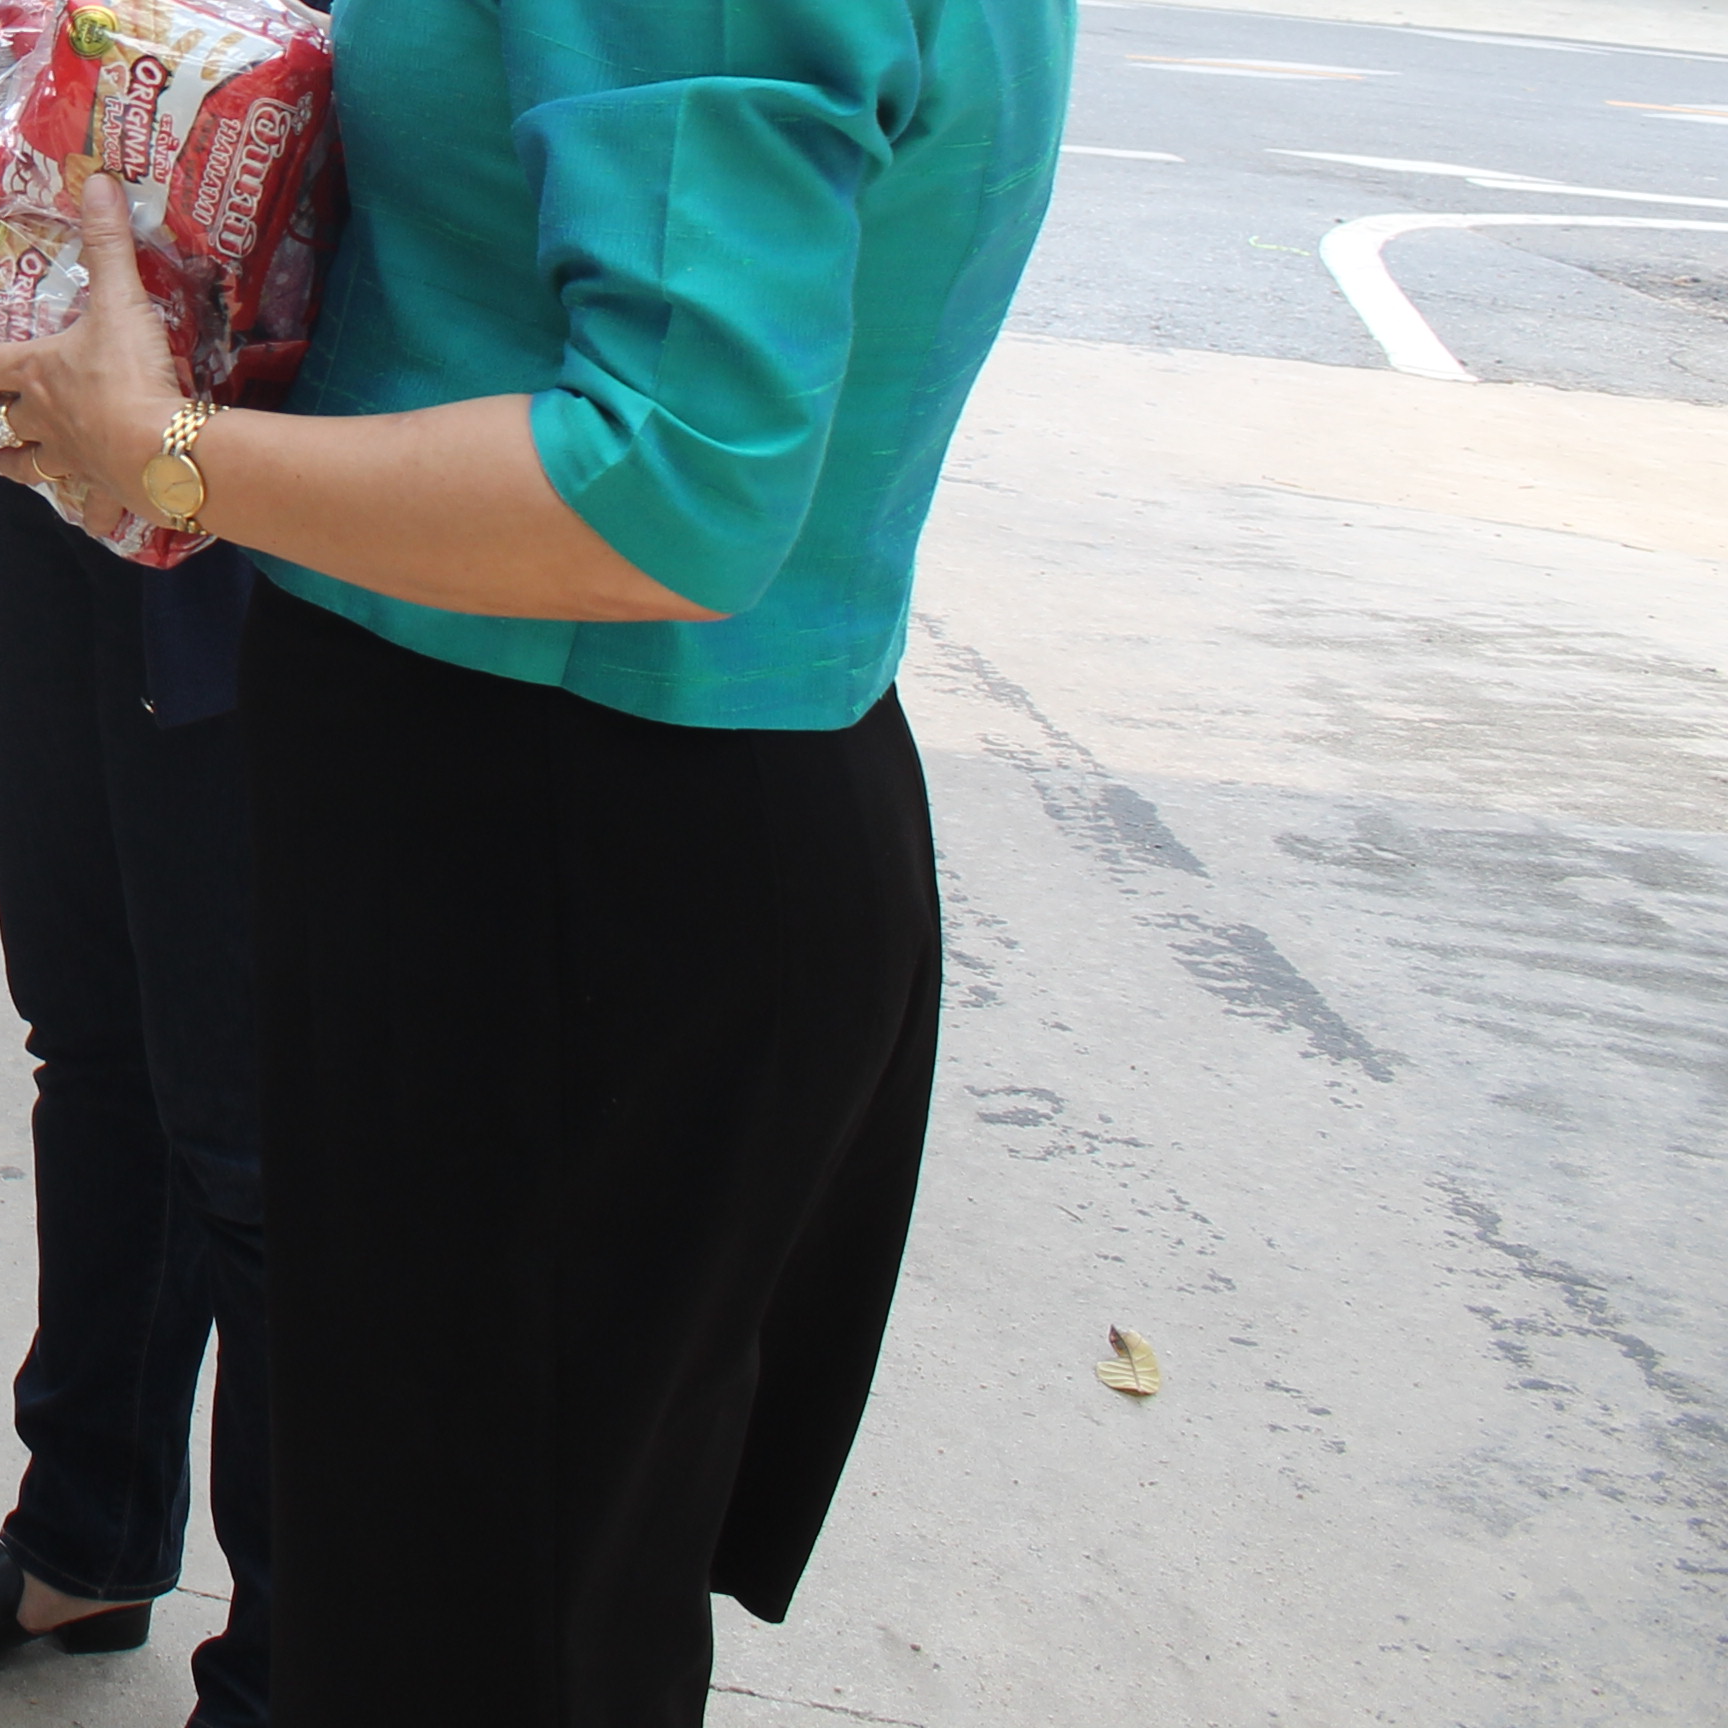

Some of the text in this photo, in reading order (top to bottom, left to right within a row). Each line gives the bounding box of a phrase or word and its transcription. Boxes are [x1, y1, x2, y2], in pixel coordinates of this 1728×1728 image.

[103, 97, 124, 172] FLAVOUR
[124, 56, 166, 181] ORIGINAL
[193, 118, 241, 226] HANAMI
